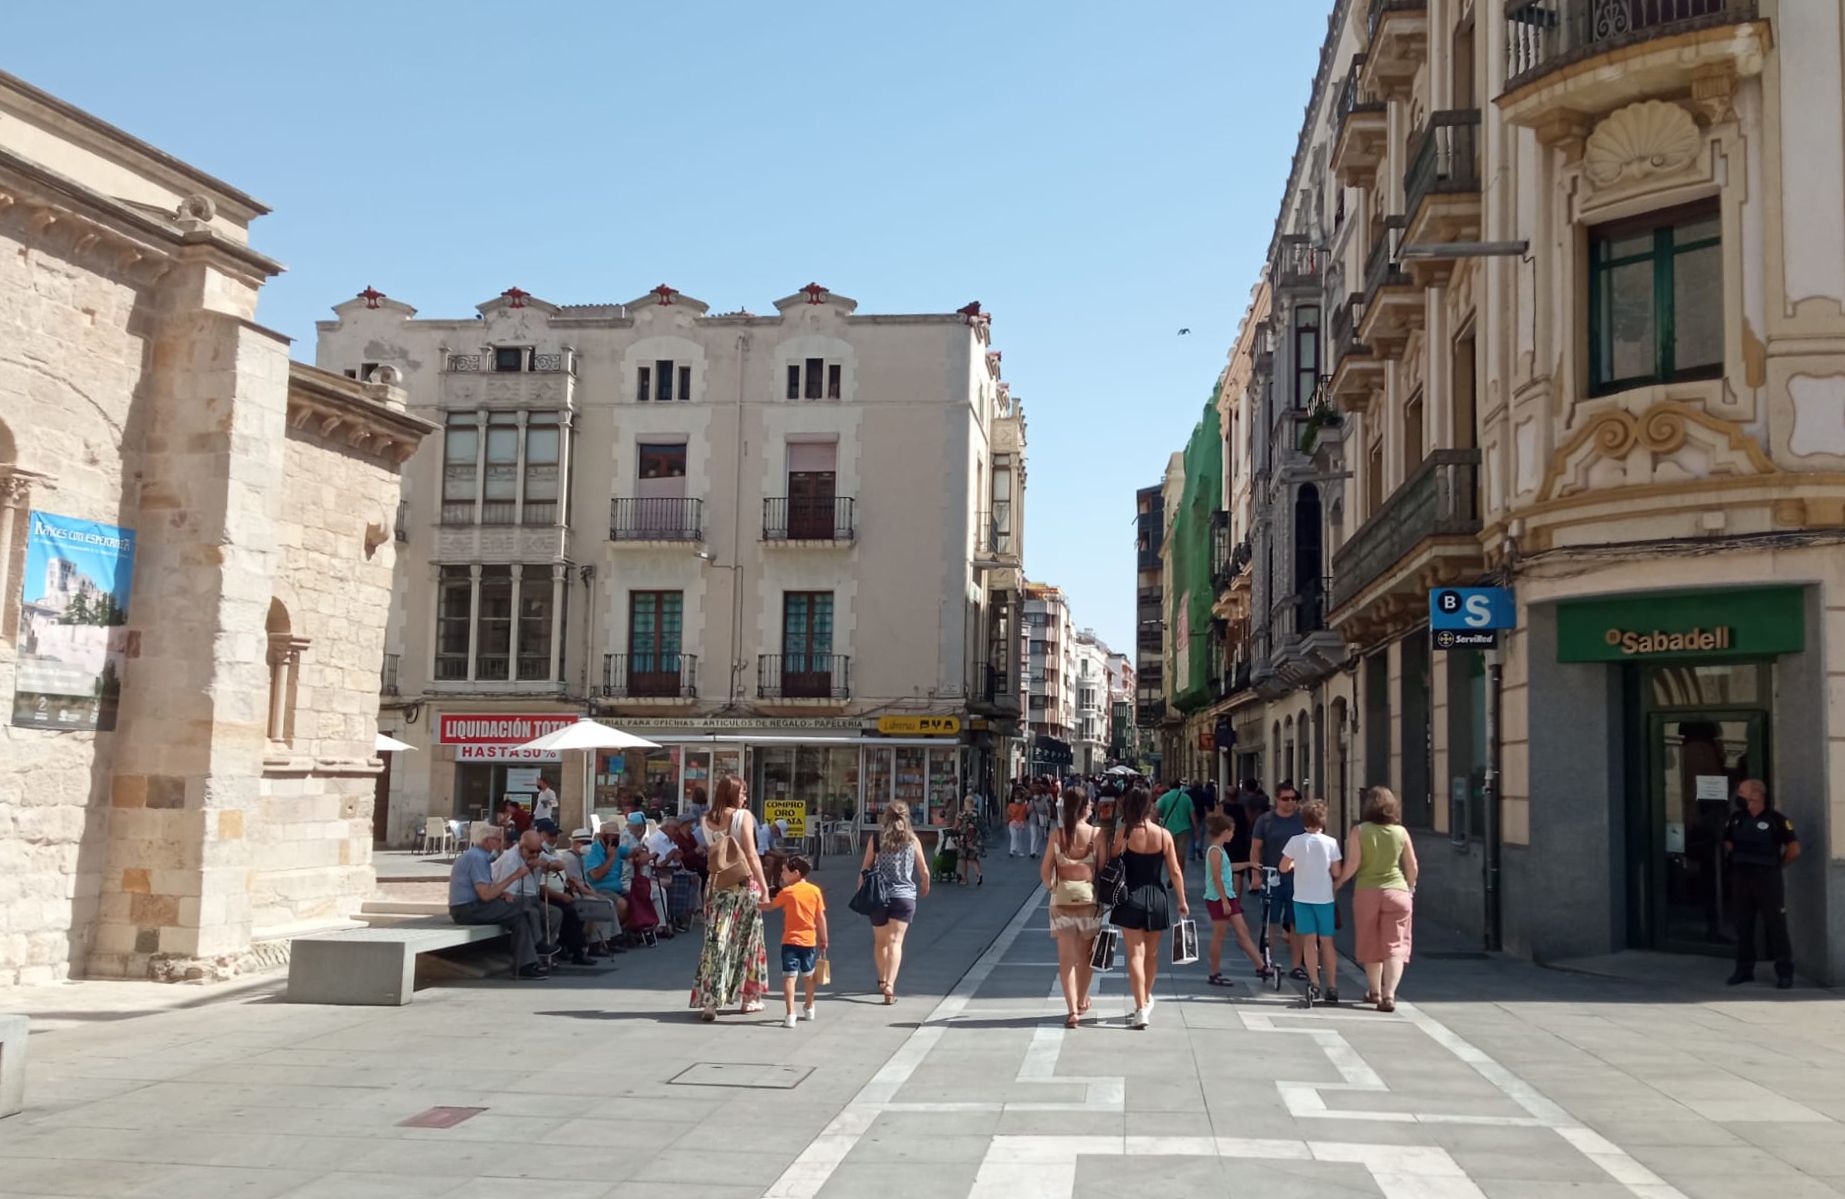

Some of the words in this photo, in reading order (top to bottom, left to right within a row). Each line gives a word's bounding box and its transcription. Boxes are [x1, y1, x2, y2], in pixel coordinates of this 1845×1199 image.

[1444, 595, 1457, 609] B
[1464, 595, 1491, 627] S
[1622, 626, 1729, 654] Sabadell
[445, 718, 531, 739] LIQUIDACIÓN
[533, 720, 571, 738] TOT
[627, 719, 651, 727] PARA
[755, 719, 765, 728] DE
[770, 719, 807, 728] REGALO
[462, 746, 520, 757] HASTA
[774, 809, 796, 817] ORO
